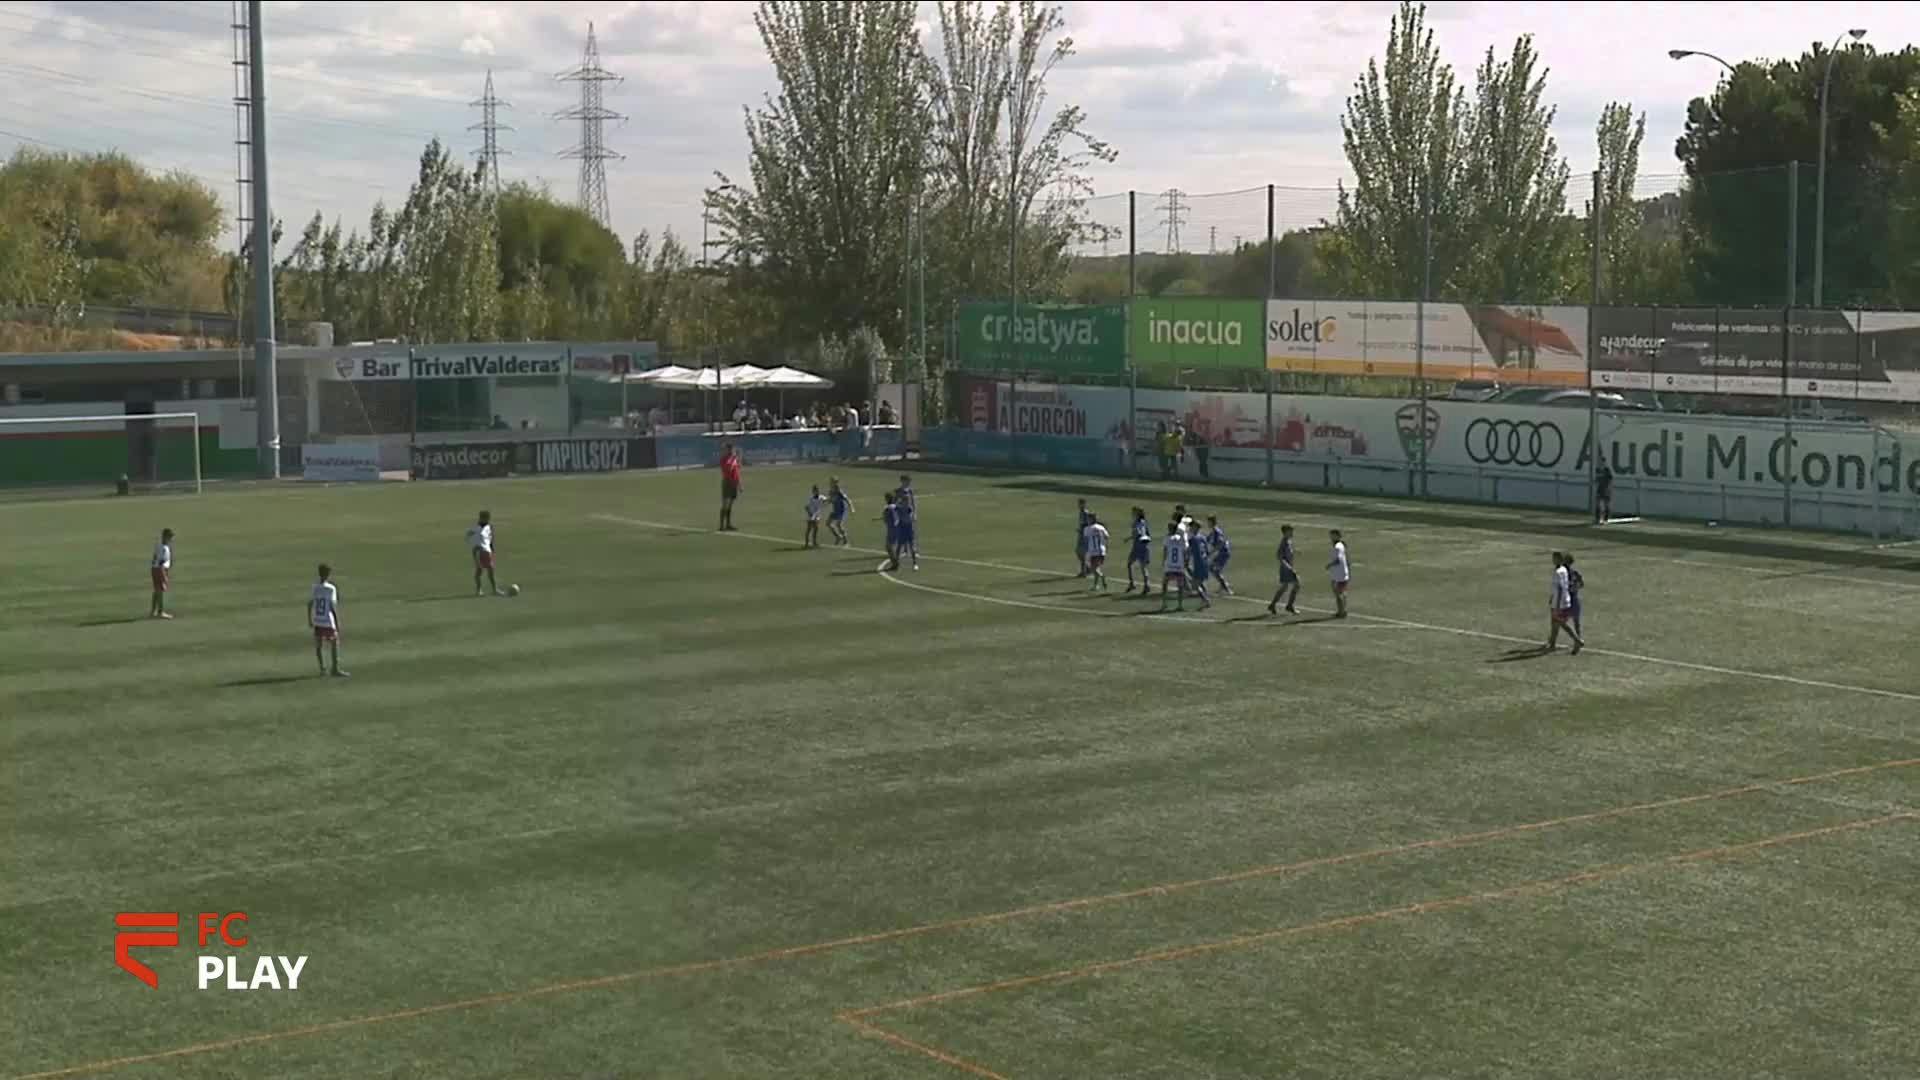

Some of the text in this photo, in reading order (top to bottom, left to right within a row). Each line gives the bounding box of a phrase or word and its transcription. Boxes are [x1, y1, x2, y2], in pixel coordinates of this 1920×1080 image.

[1149, 311, 1241, 344] inacua
[362, 359, 400, 377] Bar
[413, 356, 560, 377] TrivalValderas
[1000, 400, 1086, 435] ALCORCÓN
[1575, 423, 1684, 478] Audi
